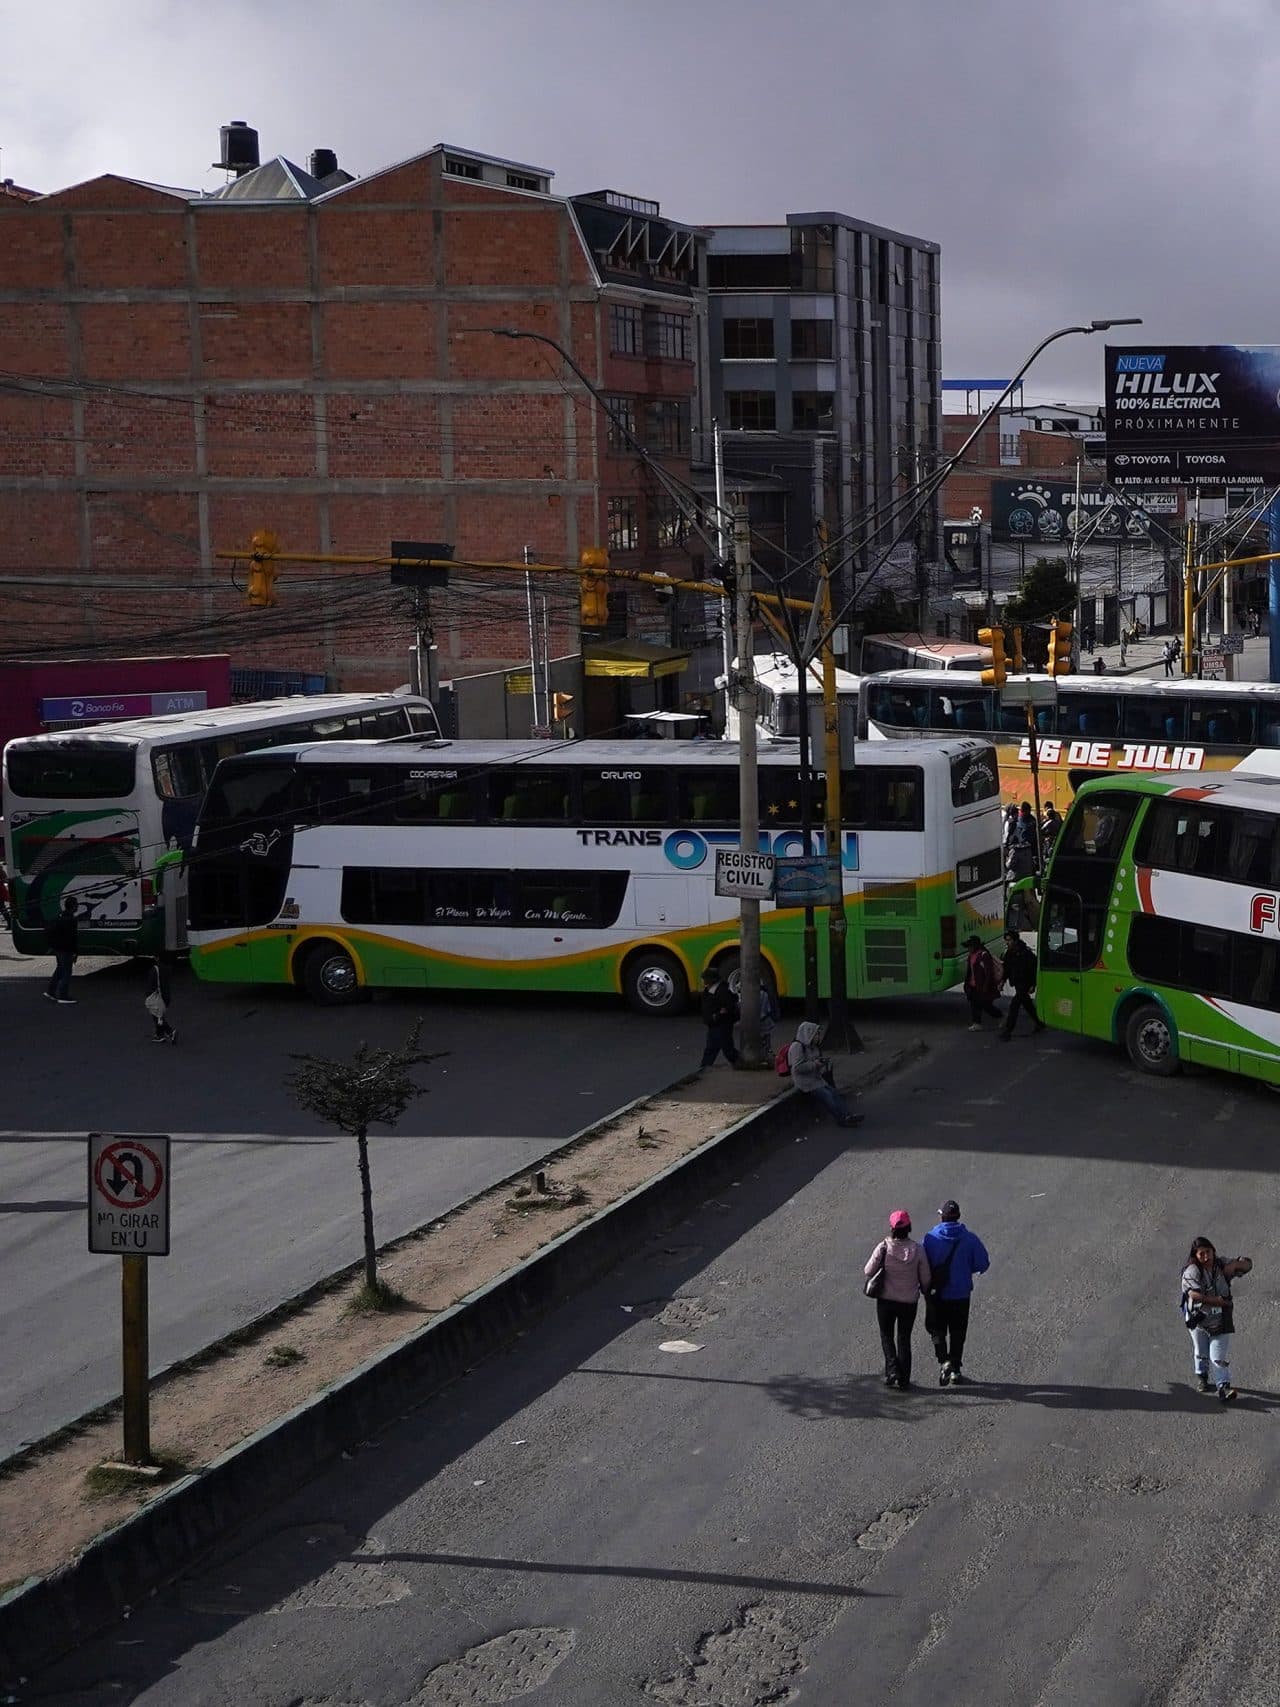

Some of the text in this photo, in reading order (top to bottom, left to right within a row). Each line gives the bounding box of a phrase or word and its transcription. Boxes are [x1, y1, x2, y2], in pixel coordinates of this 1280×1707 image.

[1118, 358, 1163, 370] NUEVA
[1115, 373, 1221, 393] HILUX
[1115, 394, 1221, 409] 100% ELÉCTRICA
[1114, 416, 1240, 429] PRÓXIMAMENTE
[1130, 455, 1171, 464] TOYOTA
[1185, 455, 1226, 464] TOYOSA
[1157, 494, 1177, 504] 2201
[167, 698, 194, 710] ATM
[1018, 738, 1206, 771] 26 DE JULIO
[601, 771, 642, 780] ORURO
[576, 830, 663, 846] TRANS
[719, 852, 774, 870] REGISTRO
[726, 870, 764, 886] CIVIL
[120, 1213, 159, 1229] GIRAR
[134, 1230, 147, 1248] U
